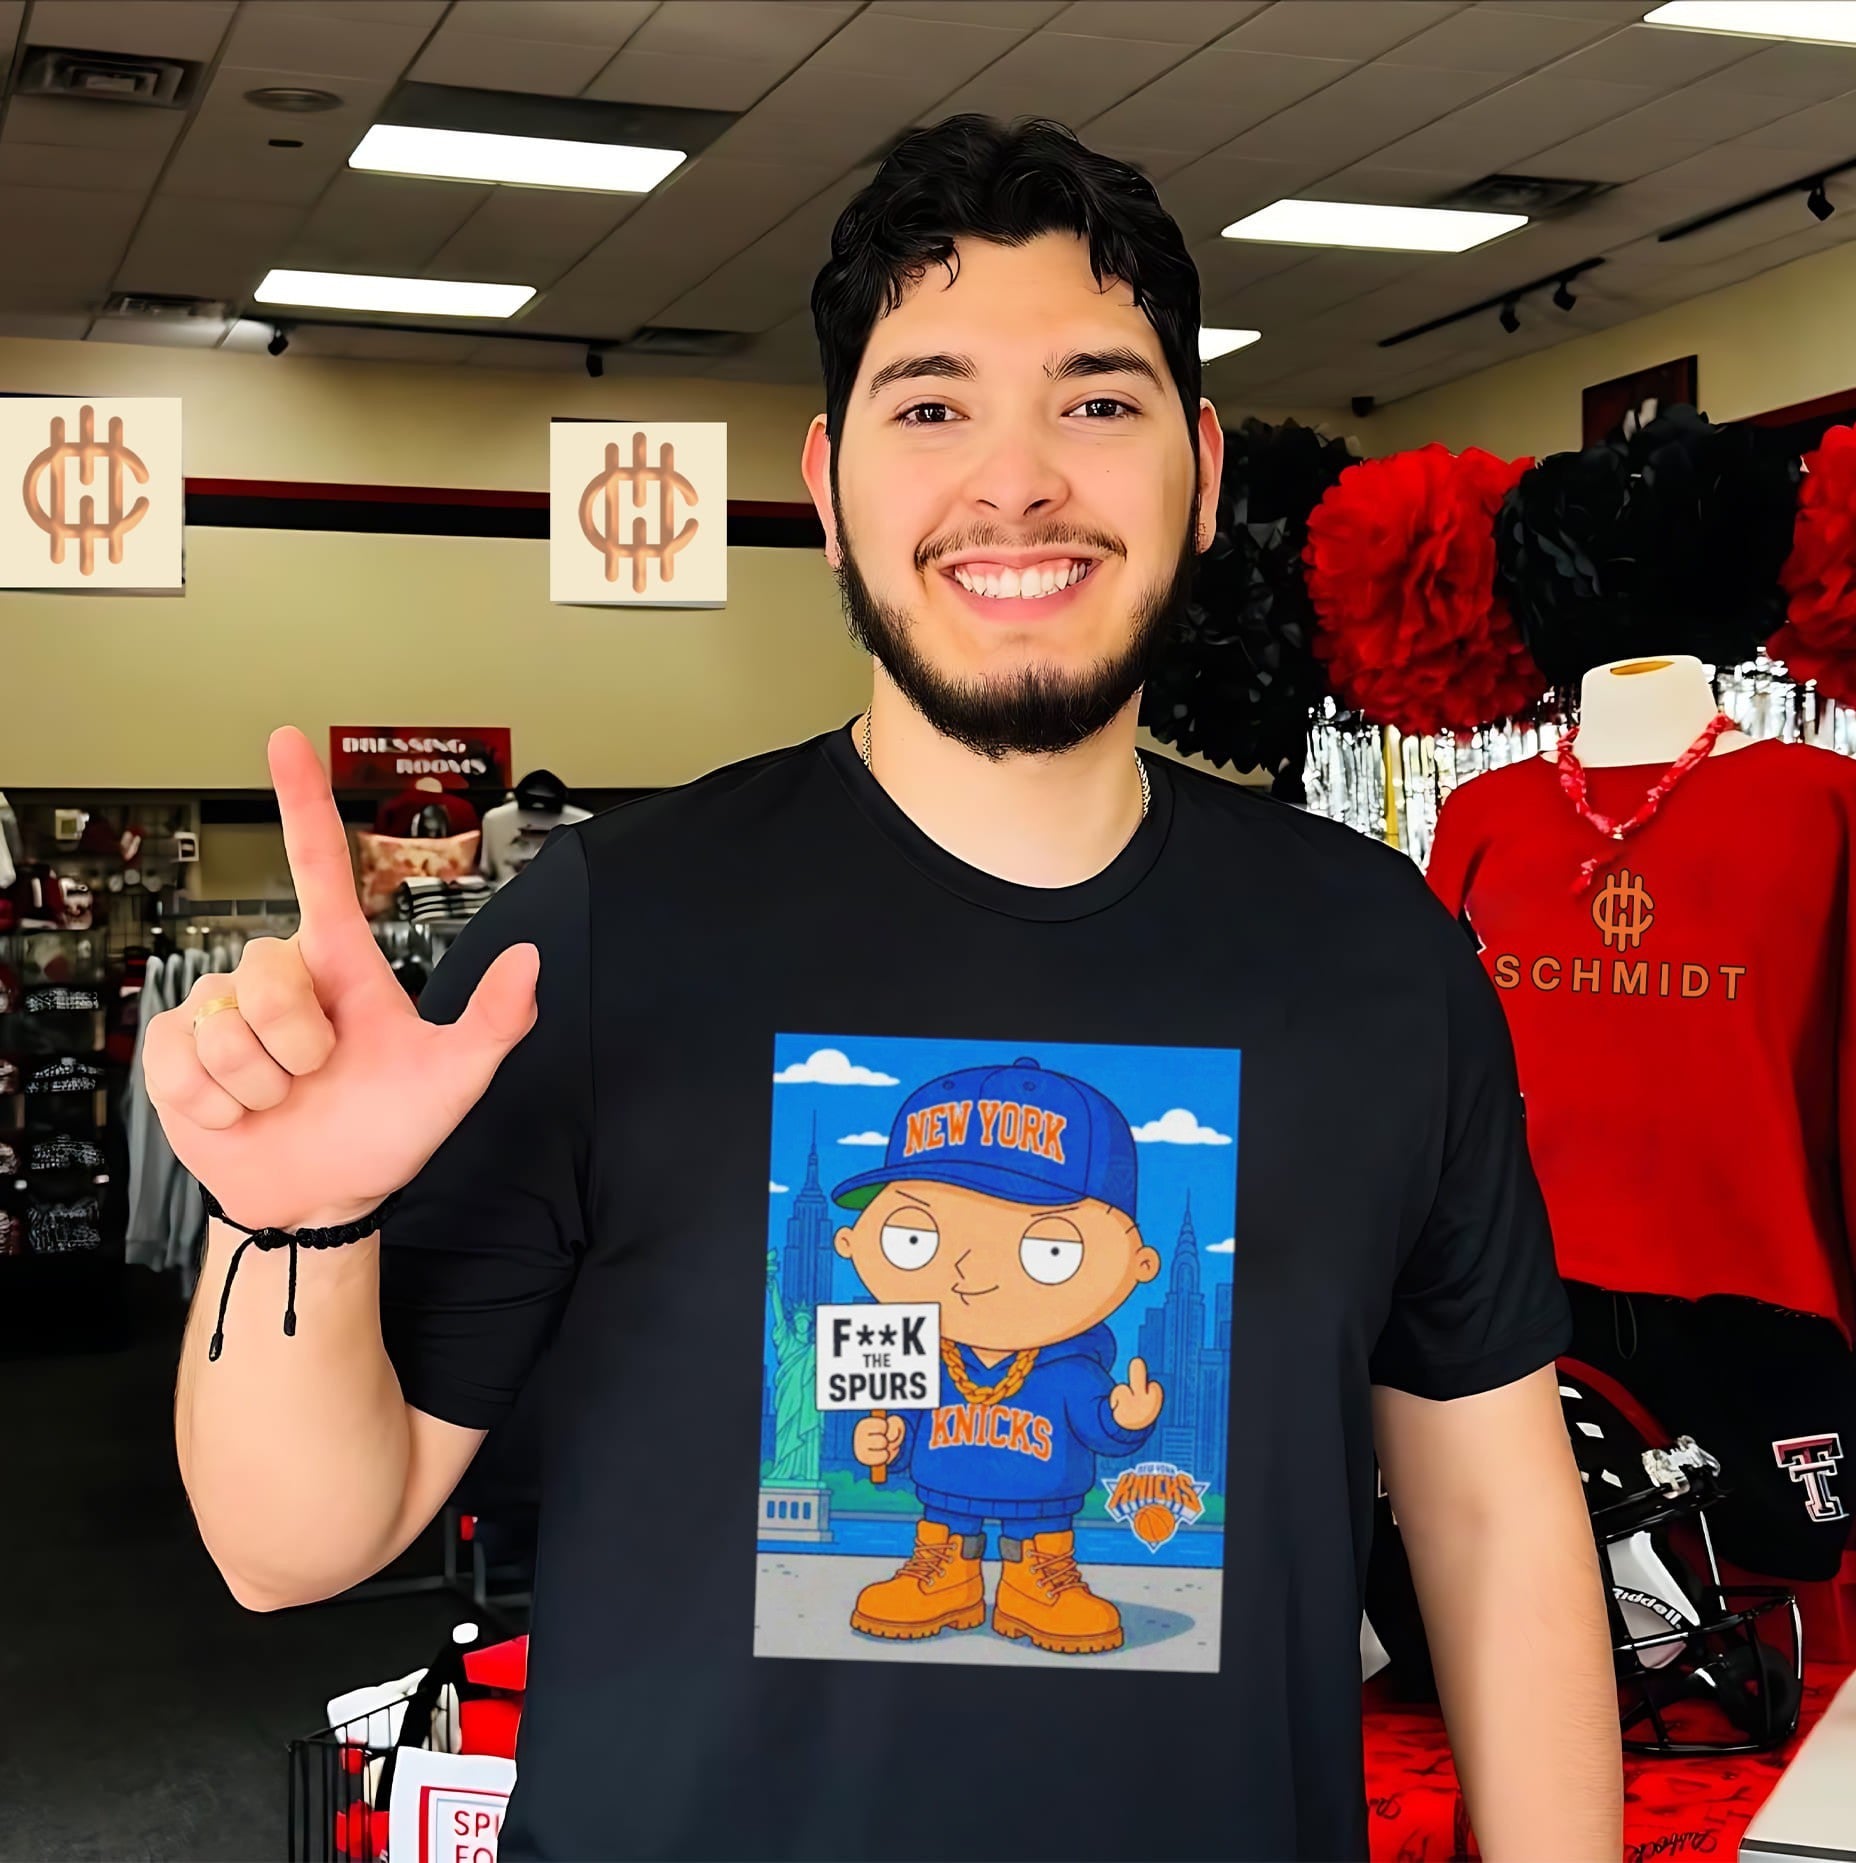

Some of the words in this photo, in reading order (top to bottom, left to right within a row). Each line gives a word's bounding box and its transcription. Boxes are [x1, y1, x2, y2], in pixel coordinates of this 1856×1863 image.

[1494, 953, 1747, 1000] SCHMIDT
[903, 1100, 973, 1157] NEW
[978, 1100, 1067, 1165] YORK
[862, 1353, 891, 1368] THE
[829, 1371, 927, 1402] SPURS
[929, 1403, 1053, 1462] KNICKS
[1109, 1473, 1202, 1512] KNICKS
